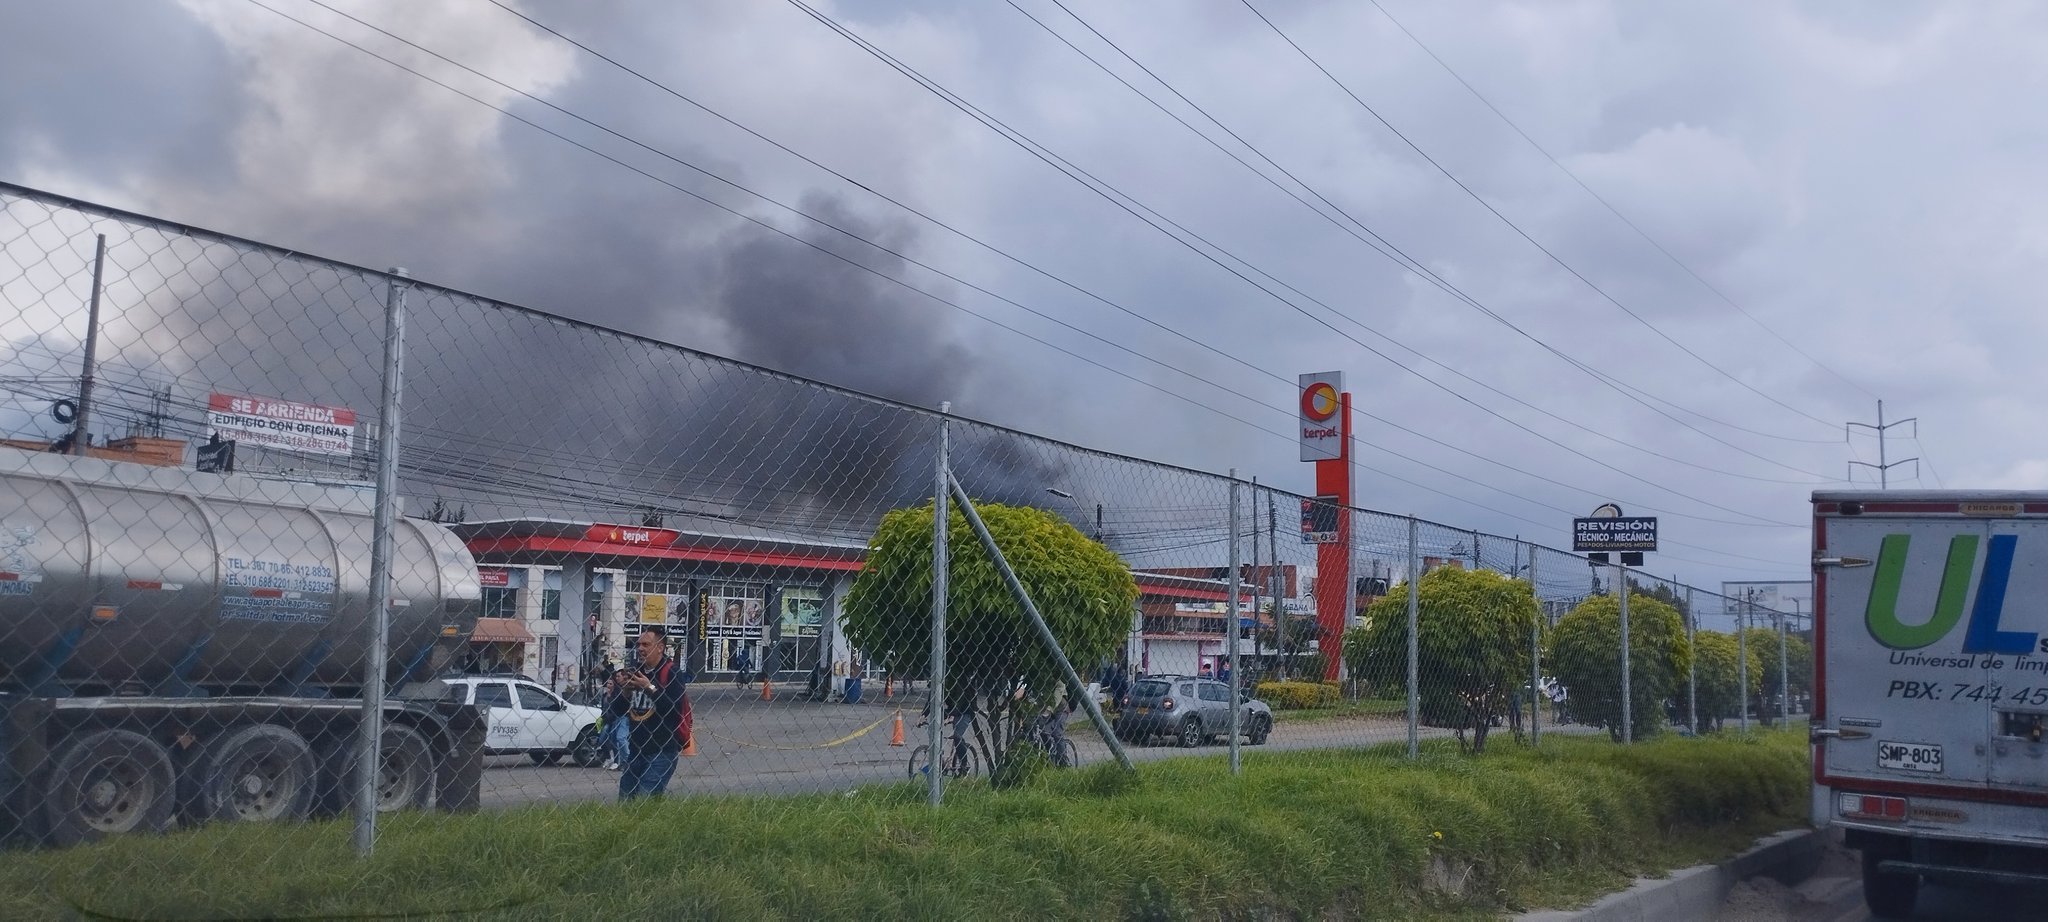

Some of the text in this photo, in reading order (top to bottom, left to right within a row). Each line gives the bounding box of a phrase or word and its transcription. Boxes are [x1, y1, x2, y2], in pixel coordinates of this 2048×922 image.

[231, 399, 252, 413] SE
[215, 414, 348, 438] EDIFICIO CON OFICINAS
[1304, 426, 1337, 440] terpel
[1577, 520, 1654, 530] REVISIÓN
[622, 530, 649, 543] terpel
[1577, 531, 1609, 541] TÉCNICO
[1614, 531, 1654, 541] MECÁNICA
[1889, 652, 1975, 668] Universal
[1981, 654, 2004, 669] de
[1887, 680, 1942, 700] PBX:
[1950, 683, 2002, 702] 744
